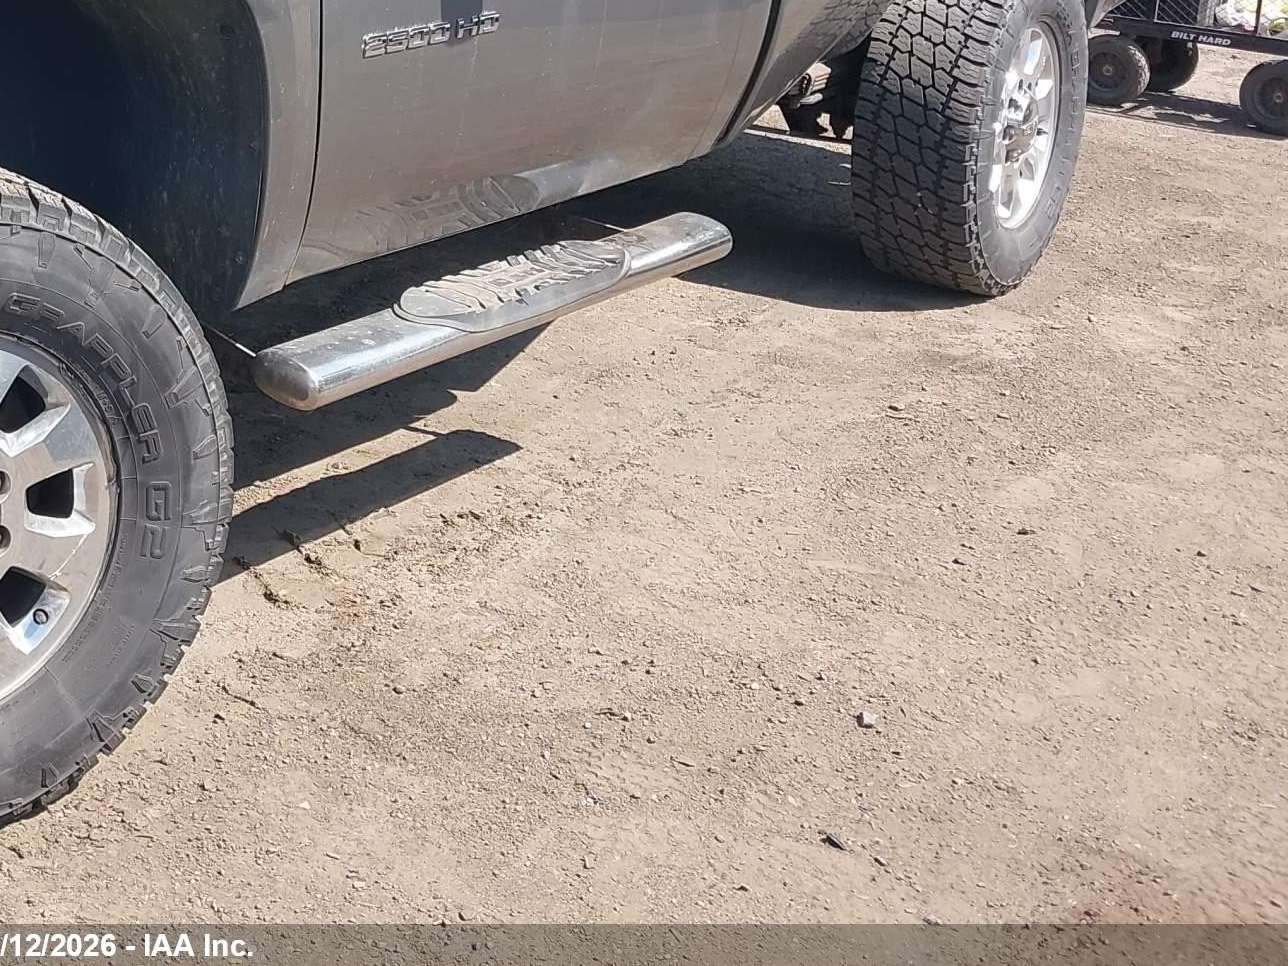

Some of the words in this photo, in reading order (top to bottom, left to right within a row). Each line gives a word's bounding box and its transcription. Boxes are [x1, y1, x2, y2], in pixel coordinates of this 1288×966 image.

[361, 19, 452, 60] 2500
[455, 10, 502, 40] HD
[1171, 31, 1197, 41] BILT
[1198, 35, 1232, 46] HARD
[6, 292, 164, 465] GRAPPLER
[139, 480, 173, 560] G2
